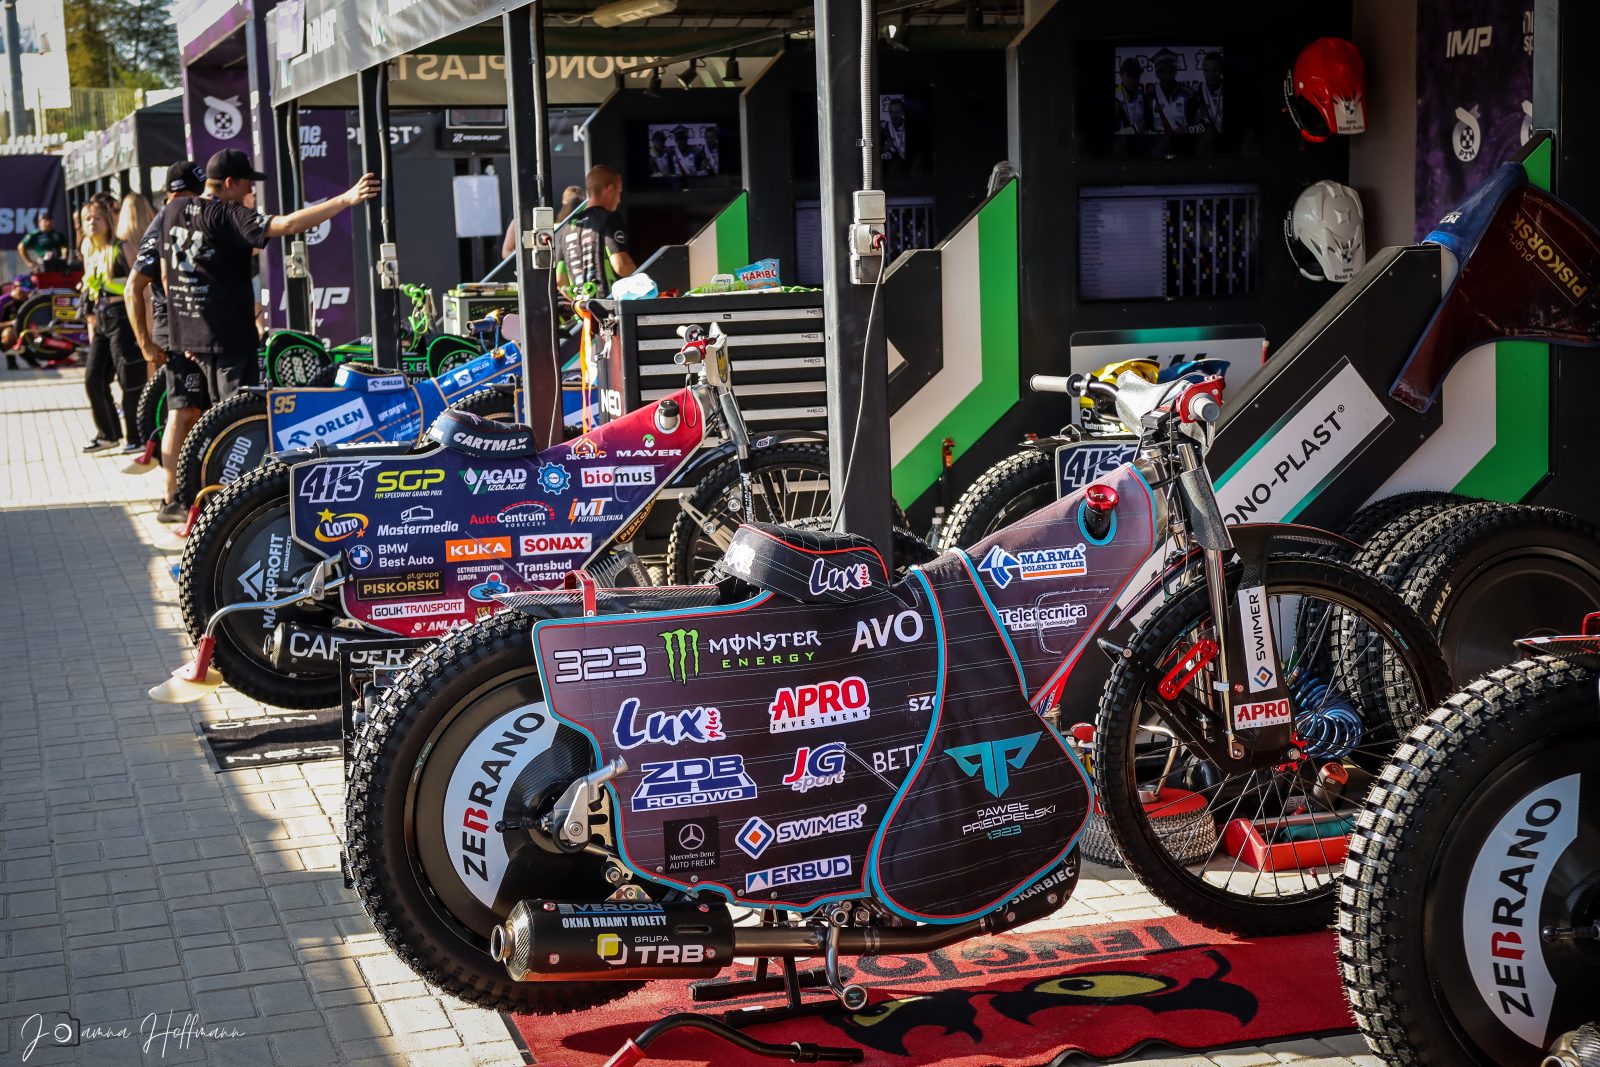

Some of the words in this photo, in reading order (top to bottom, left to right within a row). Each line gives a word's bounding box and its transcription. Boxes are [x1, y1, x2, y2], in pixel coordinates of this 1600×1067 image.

[1446, 25, 1492, 58] IMP
[1457, 149, 1476, 161] PZM
[273, 394, 297, 415] 95
[314, 406, 365, 437] ORLEN
[453, 431, 529, 452] CARTMAX
[616, 448, 683, 458] MAVER
[299, 460, 382, 504] 415
[375, 468, 446, 492] SGP
[481, 467, 528, 486] AGAD
[487, 482, 527, 492] IZOLACJE
[583, 469, 653, 486] biomus
[375, 492, 384, 500] FIM
[384, 491, 411, 499] SPEEDWAY
[411, 490, 429, 498] GRAND
[430, 489, 443, 497] PRIX
[324, 518, 359, 537] LOTTO
[377, 520, 459, 537] Mastermedia
[577, 513, 624, 523] FOTOWOLTAIKA
[378, 543, 409, 555] BMW
[449, 543, 507, 557] KUKA
[524, 536, 586, 553] SONAX
[379, 555, 405, 568] Best
[407, 554, 434, 567] Auto
[516, 559, 573, 573] Transbud
[1022, 563, 1058, 573] POLSKIE
[1060, 560, 1085, 570] FOLIE
[457, 573, 478, 582] EUROPA
[524, 571, 565, 583] Leszno
[809, 558, 862, 596] Lux
[859, 564, 871, 587] plus
[363, 578, 440, 595] PISKORSKI
[374, 605, 404, 617] GOLIK
[404, 601, 463, 615] TRANSPORT
[1000, 604, 1087, 624] Teletecnica
[1430, 582, 1452, 625] ANLAS
[850, 609, 924, 654] AVO
[1044, 618, 1076, 628] Technologies
[1249, 592, 1266, 662] SWIMER
[708, 630, 823, 657] MONSTER
[552, 644, 648, 684] 323
[721, 651, 815, 670] ENERGY
[771, 678, 868, 721] APRO
[772, 709, 869, 732] INVESTMENT
[1236, 699, 1290, 723] APRO
[613, 697, 708, 750] Lux
[706, 709, 723, 739] plus
[641, 754, 745, 786] ZDB
[784, 741, 847, 784] JG
[793, 770, 845, 793] sport
[461, 712, 546, 882] ZEBRANO
[646, 788, 744, 809] ROGOWO
[976, 802, 1030, 819] PAWEŁ
[669, 861, 690, 870] AUTO
[690, 858, 717, 868] FRELIK
[771, 858, 850, 886] ERBUD
[1012, 866, 1076, 905] SKARBIEC
[1490, 797, 1563, 1018] ZEBRANO
[561, 917, 591, 929] OKNA
[592, 916, 629, 928] BRAMY
[631, 915, 668, 928] ROLETY
[634, 935, 669, 944] GRUPA
[634, 944, 705, 965] TRB
